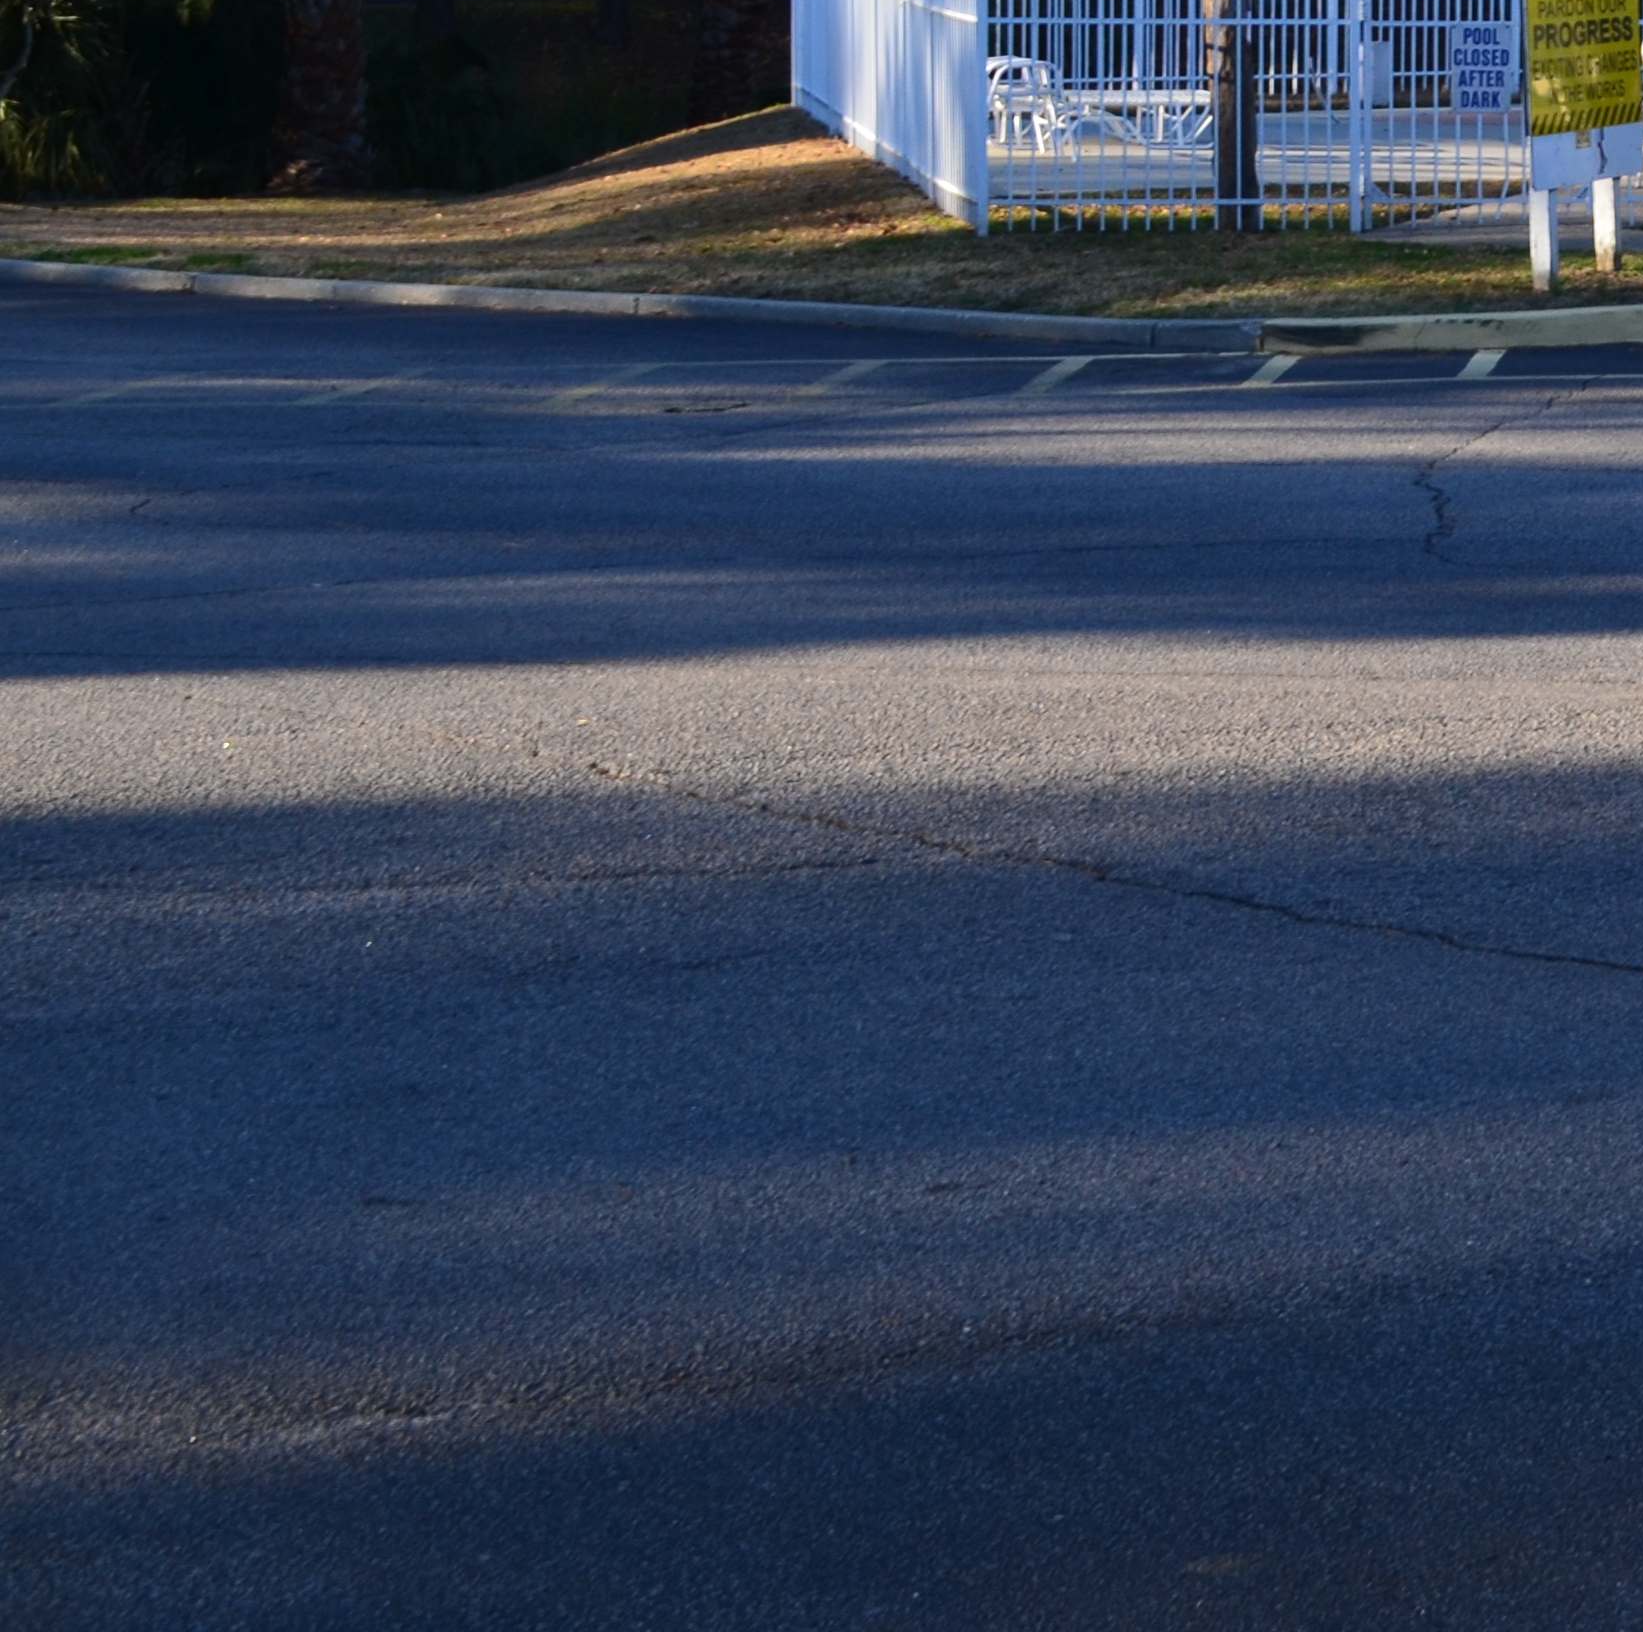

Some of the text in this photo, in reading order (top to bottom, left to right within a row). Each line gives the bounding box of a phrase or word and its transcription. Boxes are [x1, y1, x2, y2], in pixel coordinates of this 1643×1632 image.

[1463, 28, 1500, 45] POOL
[1533, 16, 1634, 50] PROGRESS
[1453, 49, 1510, 66] CLOSED
[1458, 70, 1505, 87] AFTER
[1461, 90, 1501, 108] DARK
[1563, 84, 1583, 103] THE
[1587, 79, 1626, 100] WORKS
